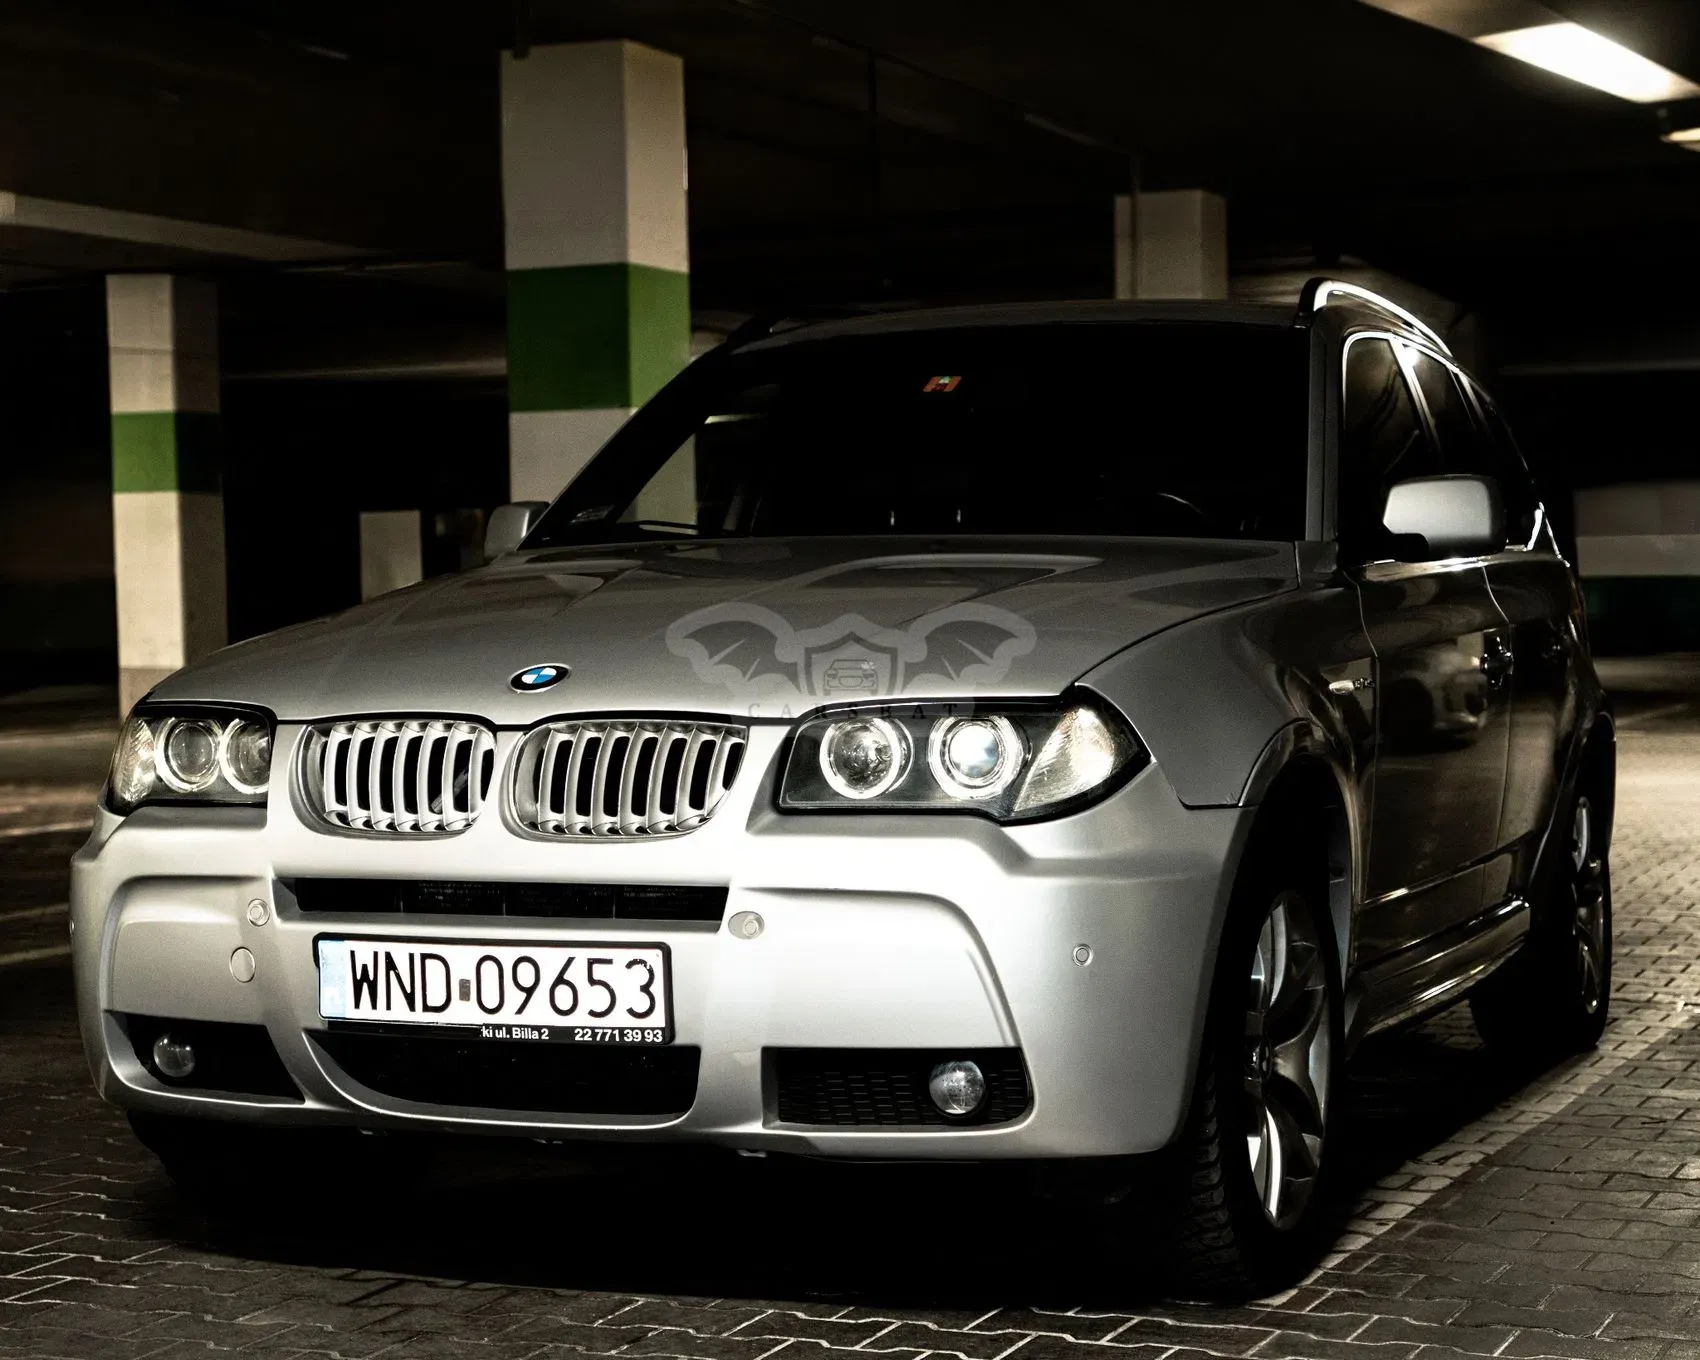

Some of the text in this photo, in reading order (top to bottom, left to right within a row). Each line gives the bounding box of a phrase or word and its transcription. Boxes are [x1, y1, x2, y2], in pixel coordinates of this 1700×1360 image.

[350, 950, 657, 1019] WND 09653
[480, 1026, 663, 1043] ki ul. Billa 2 22 771 39 93
